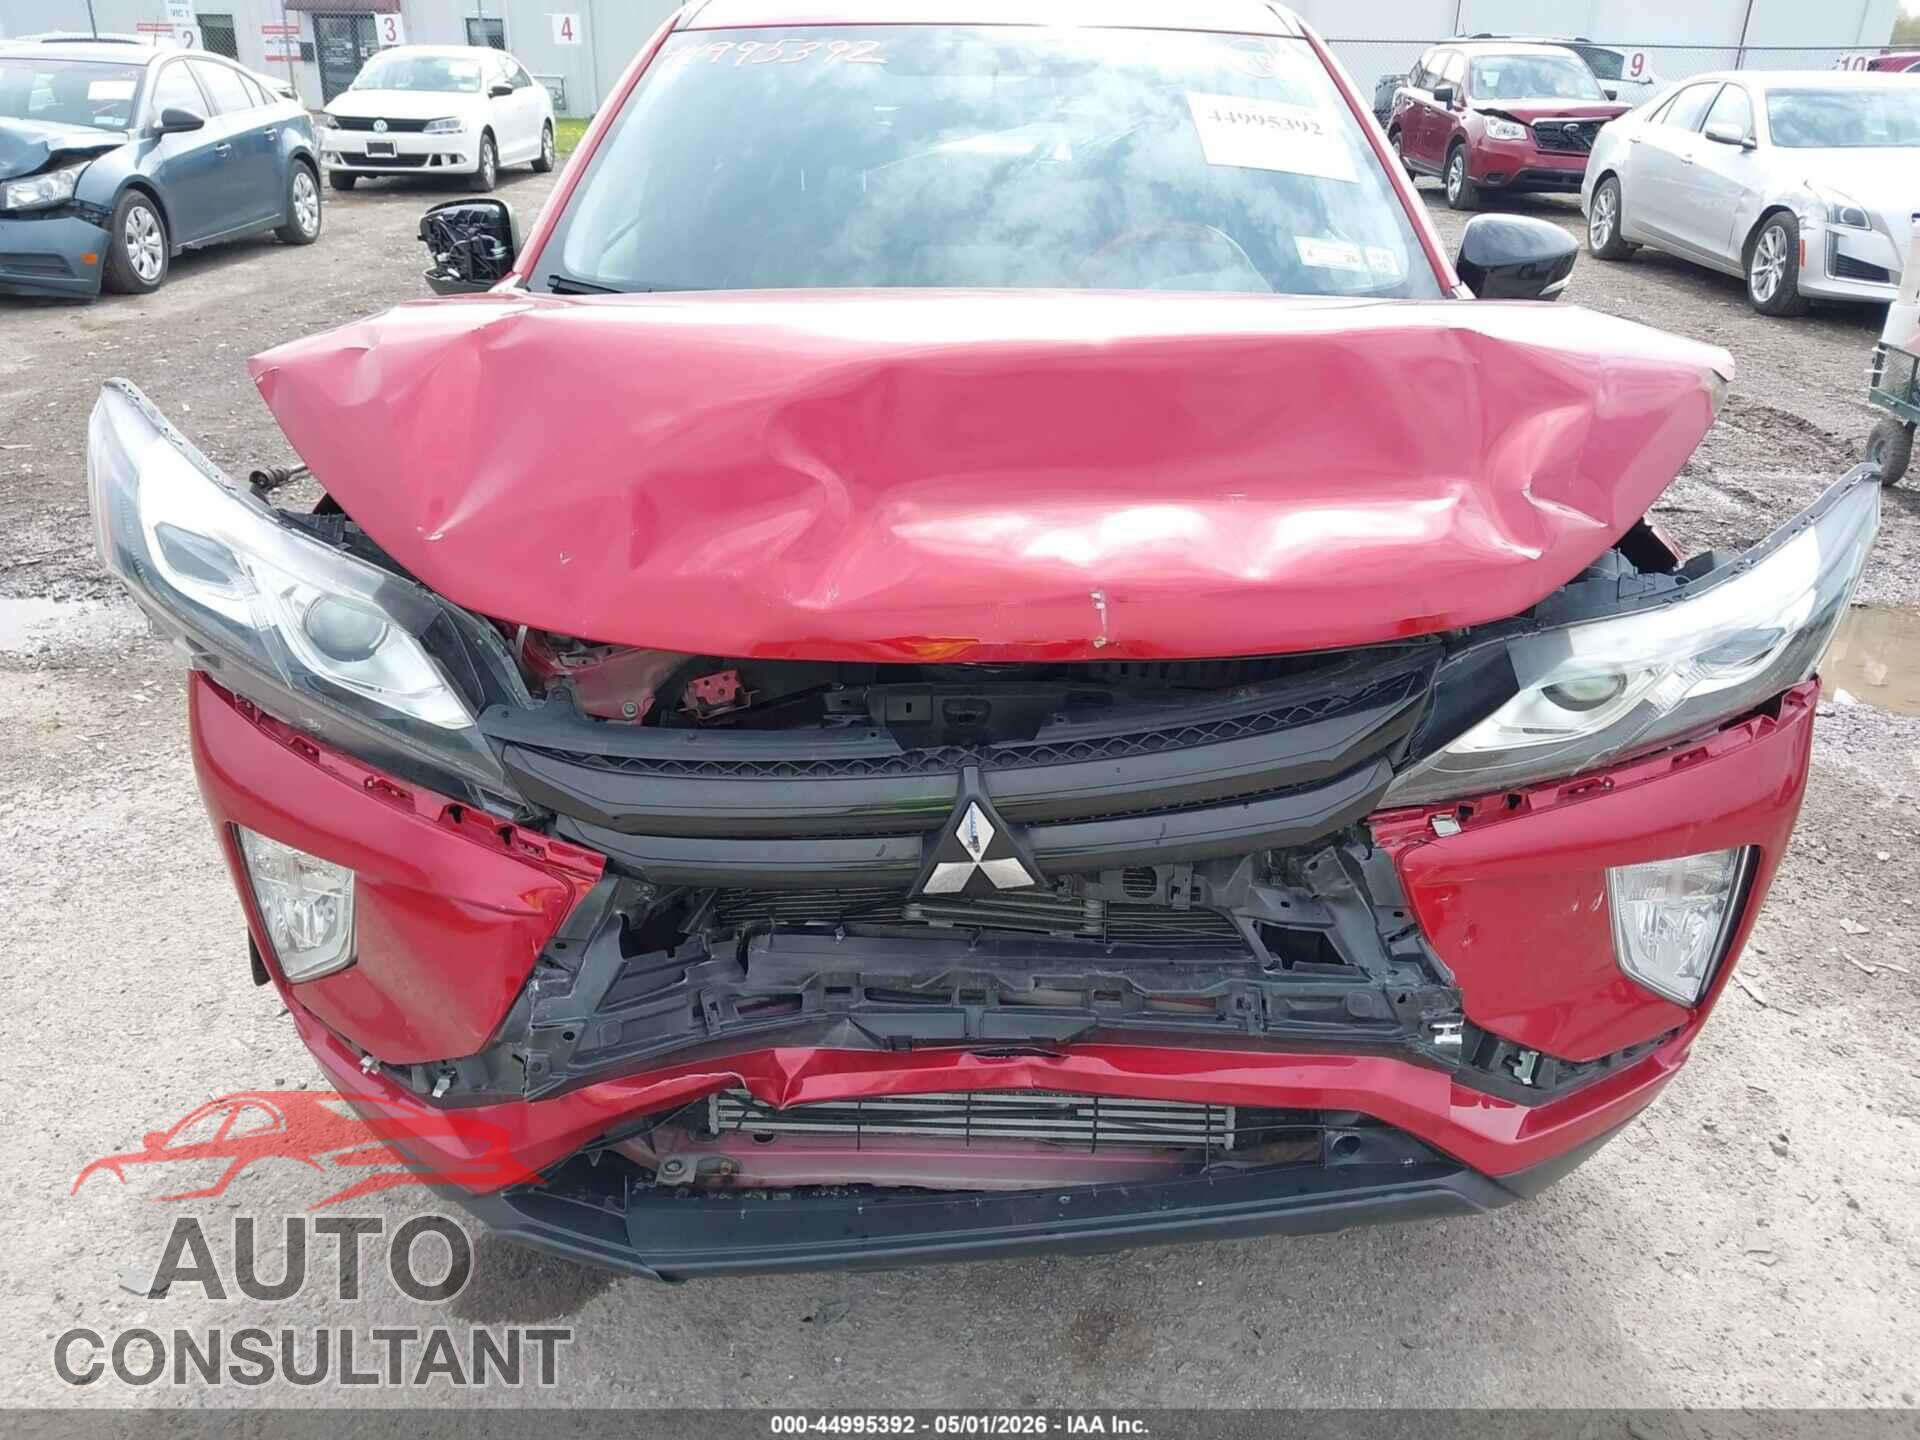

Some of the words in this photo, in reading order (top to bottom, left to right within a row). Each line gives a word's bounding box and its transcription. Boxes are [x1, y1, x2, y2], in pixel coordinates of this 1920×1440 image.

[182, 30, 194, 50] 2
[383, 17, 397, 43] 3
[560, 16, 574, 42] 4
[1630, 52, 1645, 78] 9
[1208, 109, 1325, 136] 44995392
